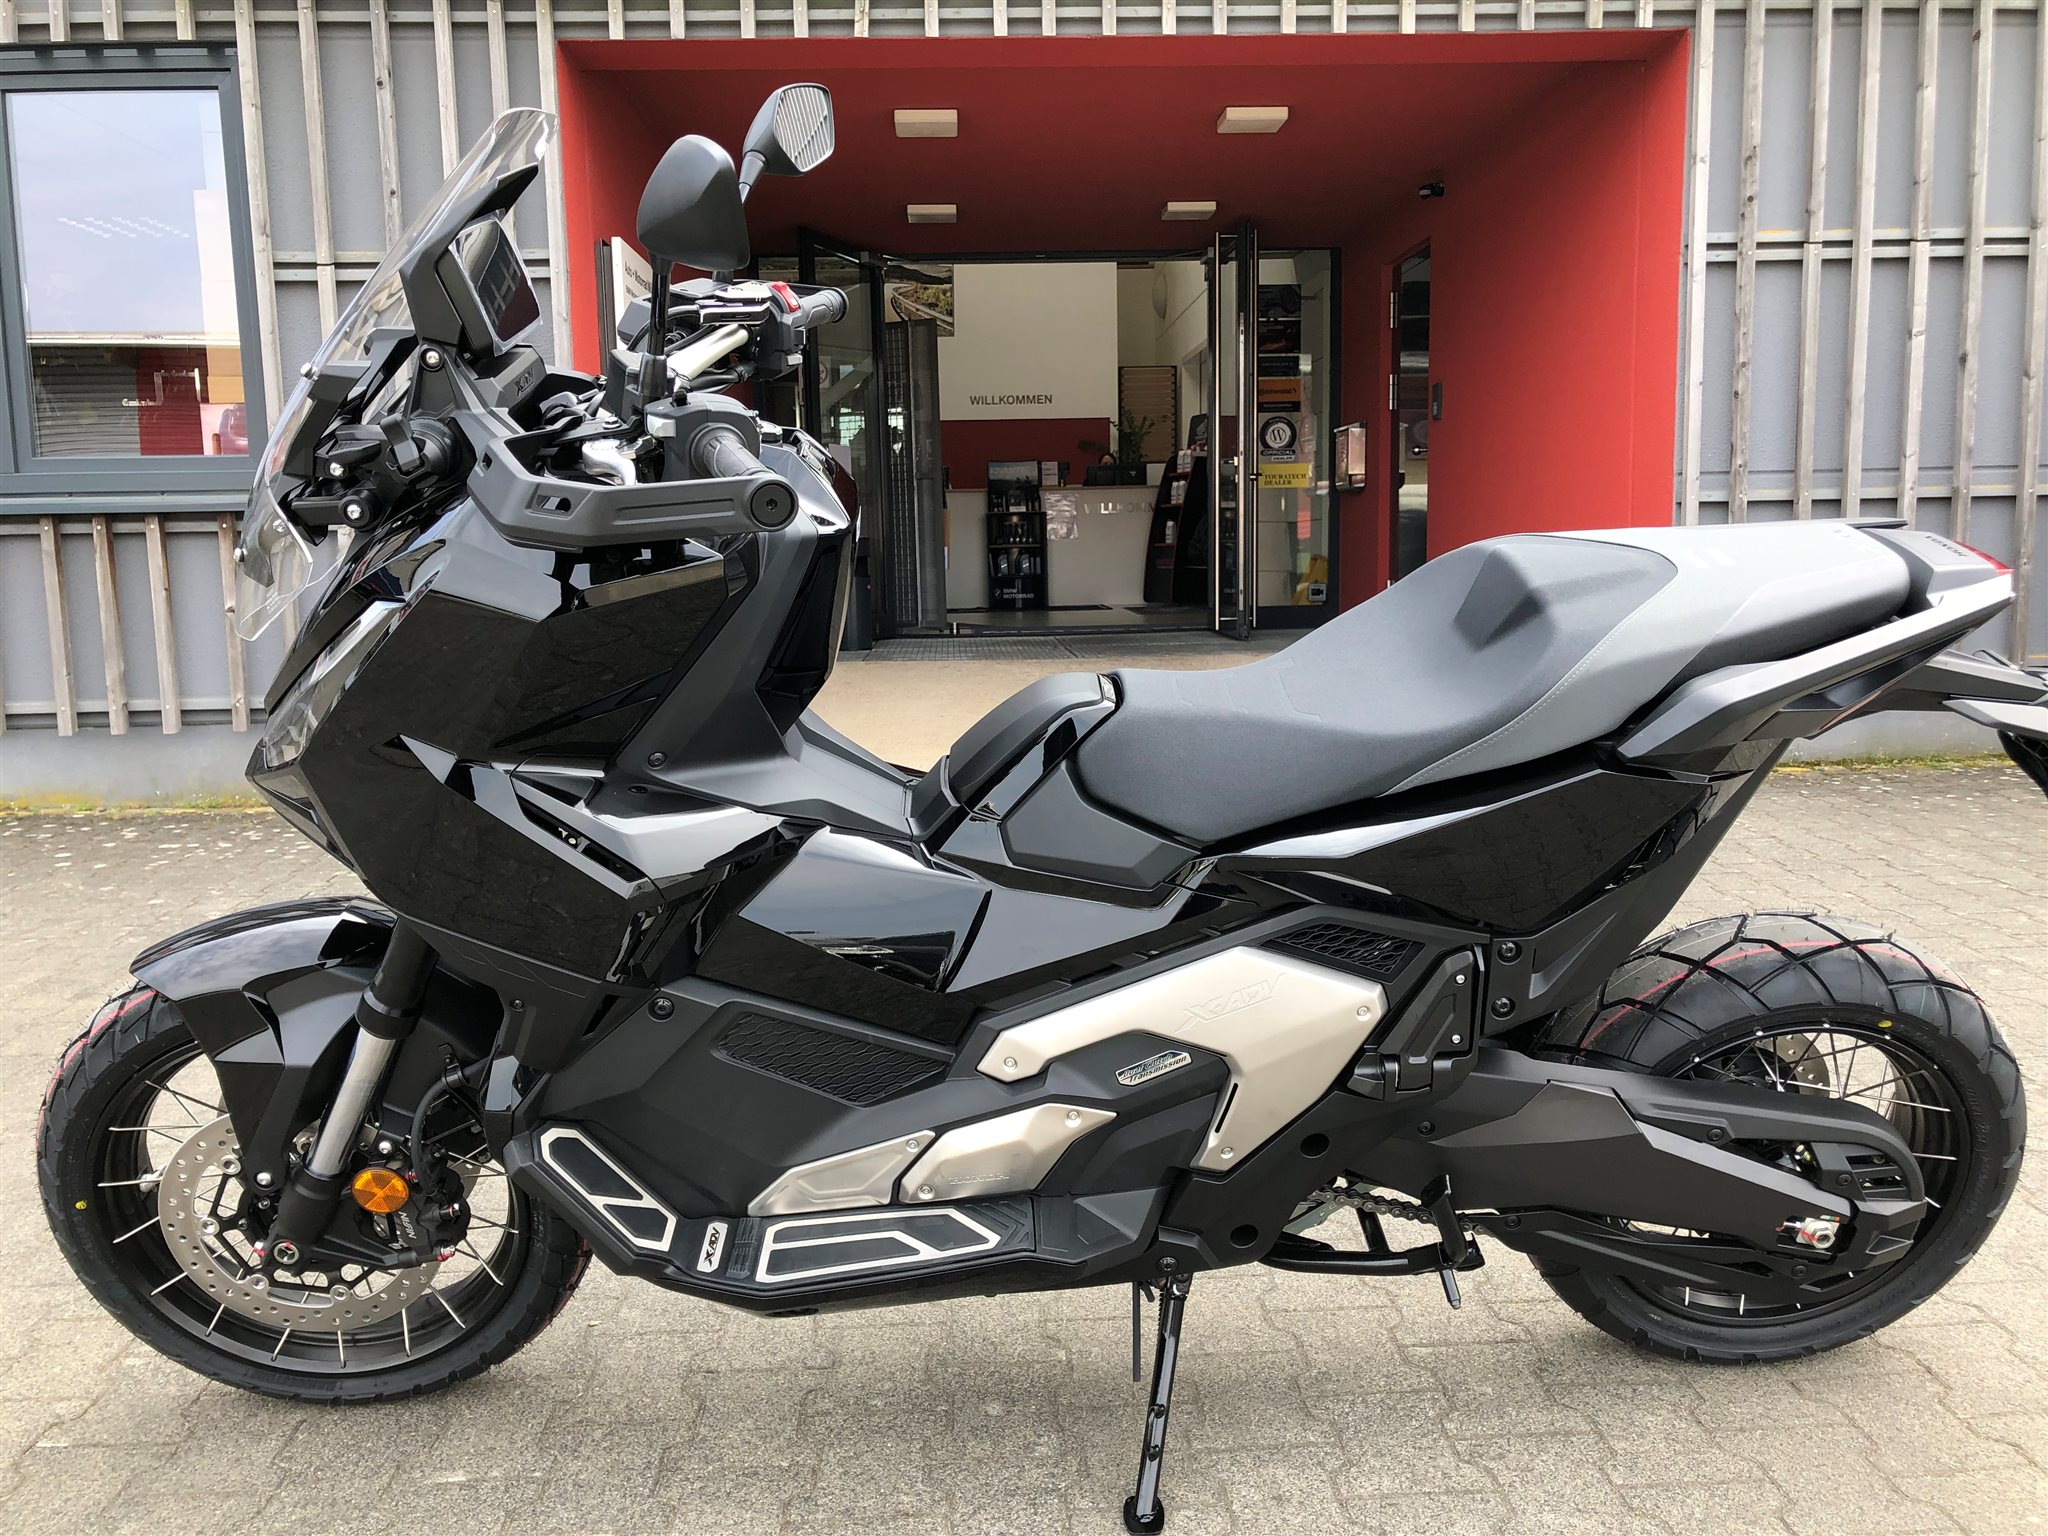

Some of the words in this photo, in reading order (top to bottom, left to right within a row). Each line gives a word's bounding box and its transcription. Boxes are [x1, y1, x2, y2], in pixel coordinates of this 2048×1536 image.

[969, 394, 1053, 406] WILLKOMMEN
[1122, 1056, 1187, 1083] Transmission
[948, 1171, 1011, 1185] HONDA
[398, 1211, 417, 1240] NISSIN
[703, 1226, 721, 1268] X-ADV
